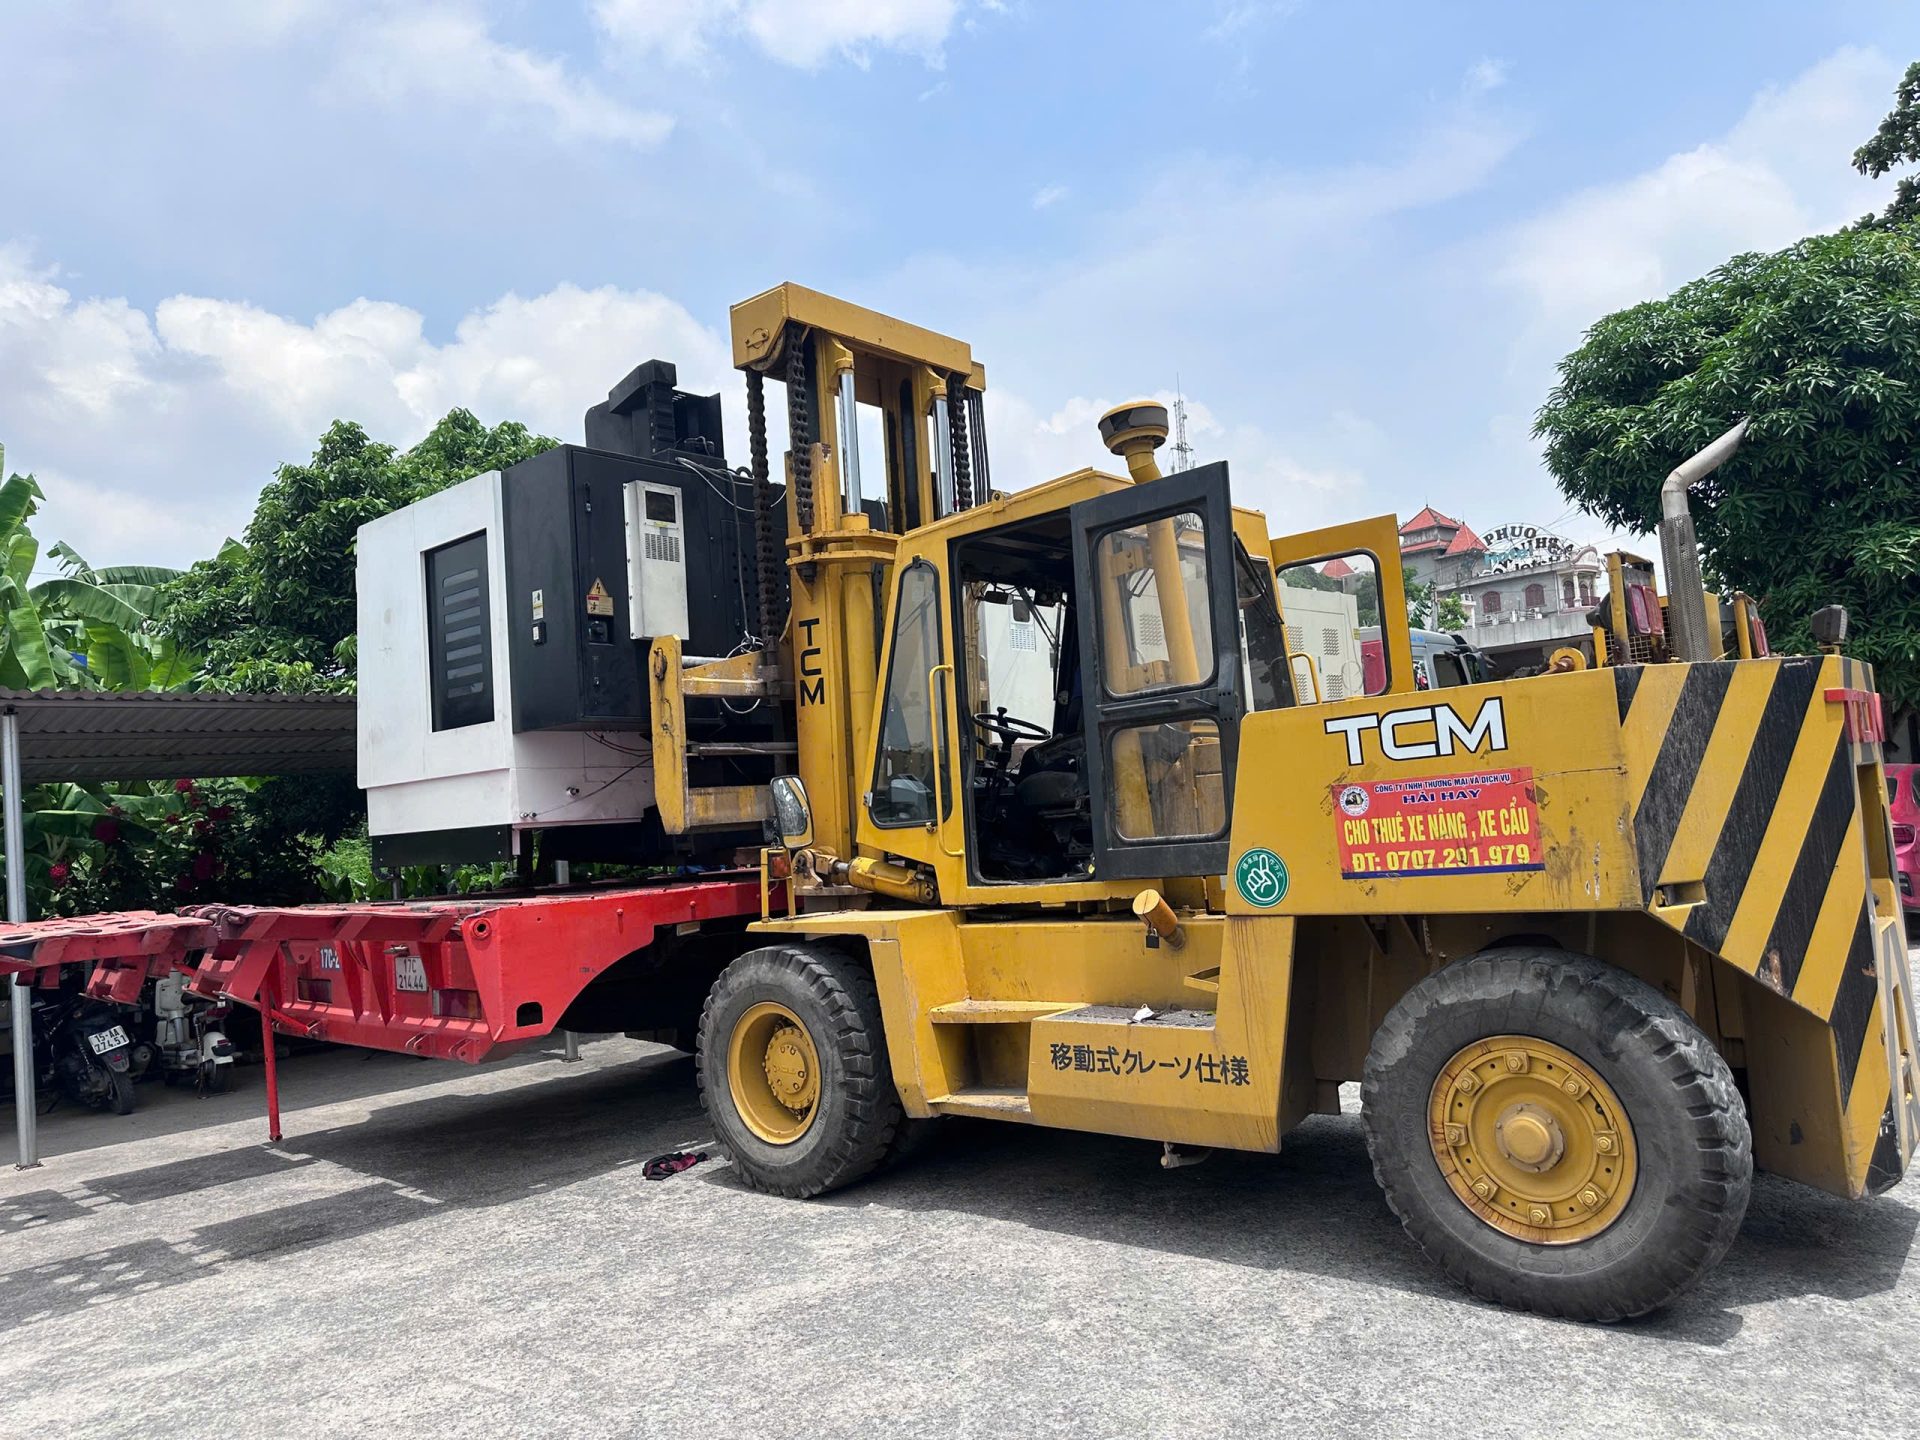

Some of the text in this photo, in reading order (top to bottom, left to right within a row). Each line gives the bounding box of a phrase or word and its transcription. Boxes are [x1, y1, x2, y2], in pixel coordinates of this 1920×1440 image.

[799, 618, 825, 707] TCM
[1324, 696, 1508, 766] TCM
[1375, 783, 1394, 794] CÔNG
[1395, 783, 1403, 793] TY
[1404, 781, 1423, 792] TNHH
[1424, 778, 1452, 790] THƯƠNG
[1441, 789, 1481, 801] HAY
[1343, 818, 1371, 846] CHO
[1371, 811, 1407, 843] THUÊ
[1407, 815, 1427, 842] XE
[1428, 808, 1468, 840] NÂNG
[1478, 809, 1498, 838] XE
[1499, 796, 1530, 836] CẨU
[1352, 843, 1530, 873] ĐT: 0707.291.979
[403, 959, 417, 974] 17C
[398, 974, 424, 990] 214.44
[94, 1028, 120, 1043] 15-AA
